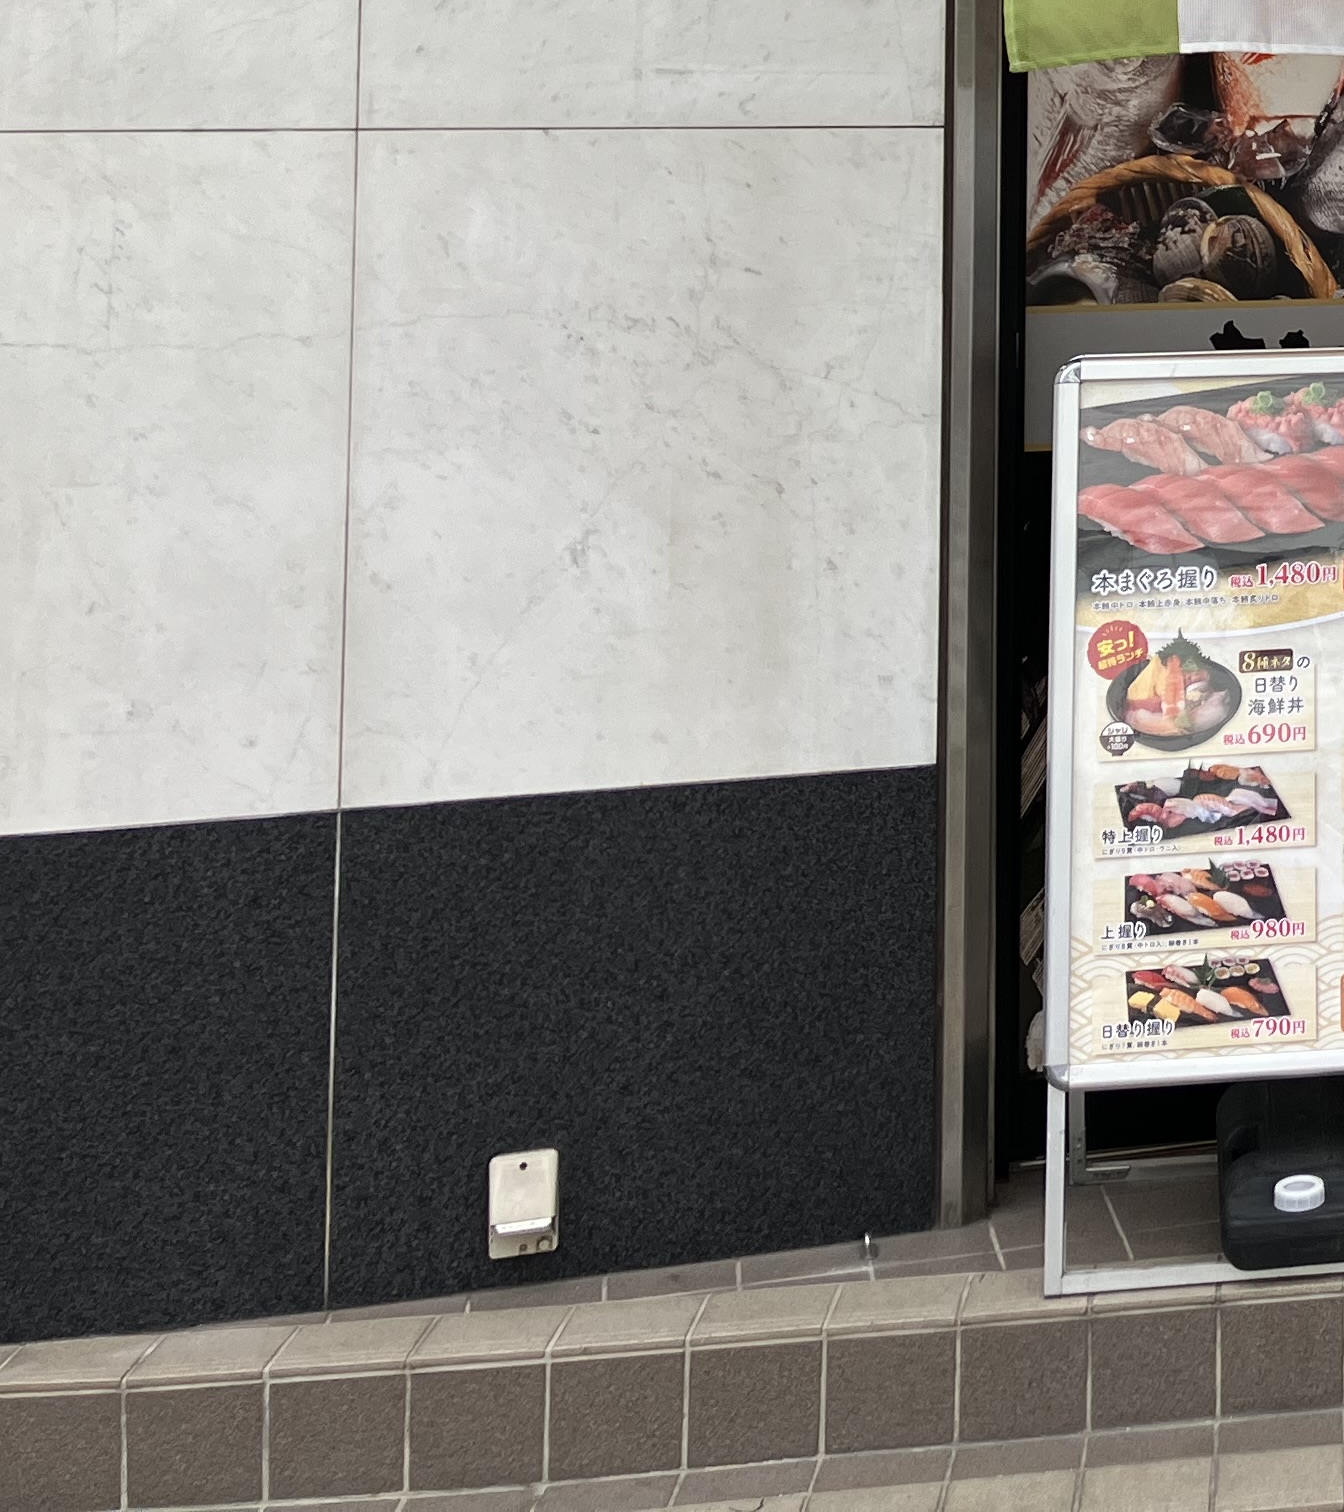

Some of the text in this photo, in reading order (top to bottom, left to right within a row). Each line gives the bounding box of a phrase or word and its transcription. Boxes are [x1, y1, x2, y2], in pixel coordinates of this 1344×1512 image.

[1093, 567, 1216, 593] 本まぐろ握り
[1096, 630, 1135, 658] 安っ!
[1254, 675, 1299, 693] 日替り
[1248, 698, 1304, 716] 海鮮丼
[1102, 825, 1163, 845] 特上握り
[1101, 921, 1147, 940] 上握り
[1102, 1020, 1176, 1039] 日替り握り
